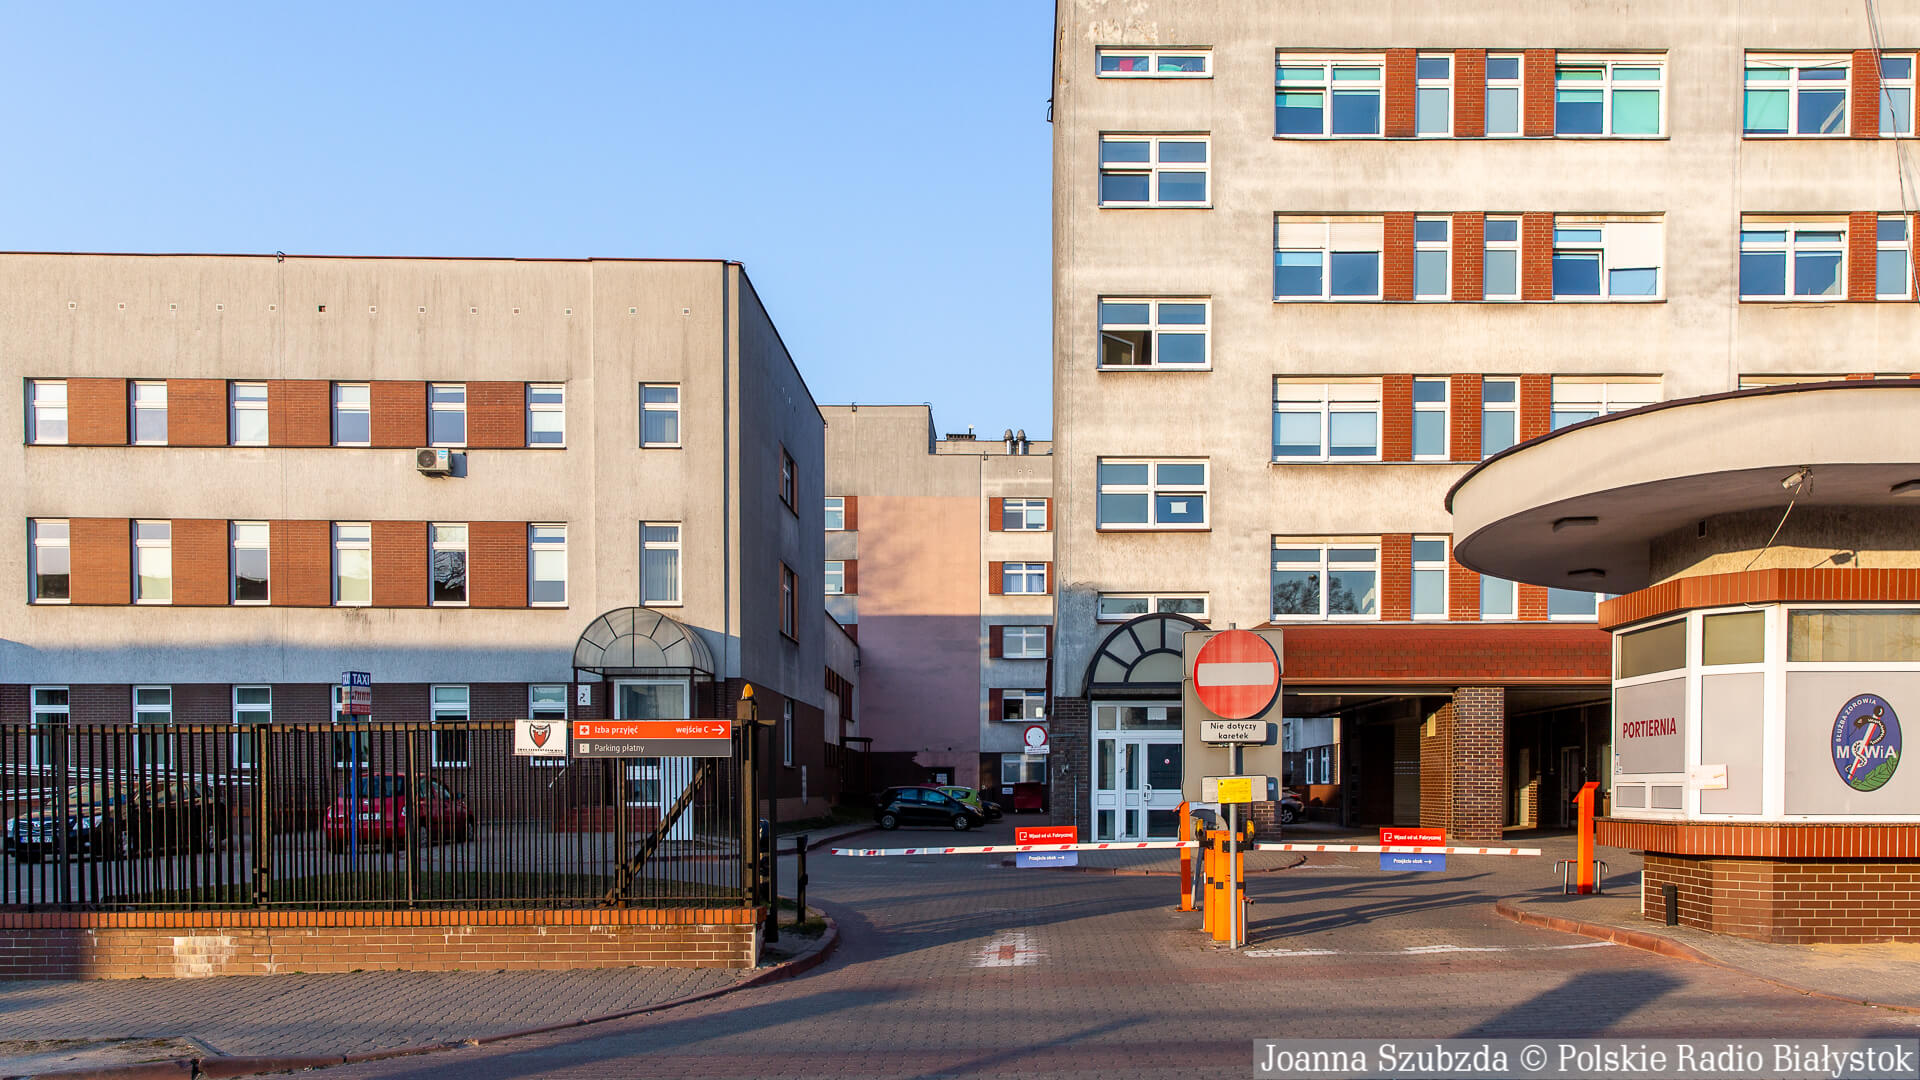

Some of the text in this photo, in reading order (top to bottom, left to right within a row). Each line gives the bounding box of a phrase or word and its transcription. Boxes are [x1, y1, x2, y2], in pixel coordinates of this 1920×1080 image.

[352, 673, 370, 686] TAXI
[1845, 698, 1877, 715] ZDROWIA
[611, 725, 638, 736] przyjęć
[675, 725, 709, 734] wejście C
[1210, 722, 1257, 731] Nie dotyczy
[1623, 717, 1677, 739] PORTIERNIA
[1218, 732, 1249, 740] karetek
[594, 743, 645, 753] Parking płatny
